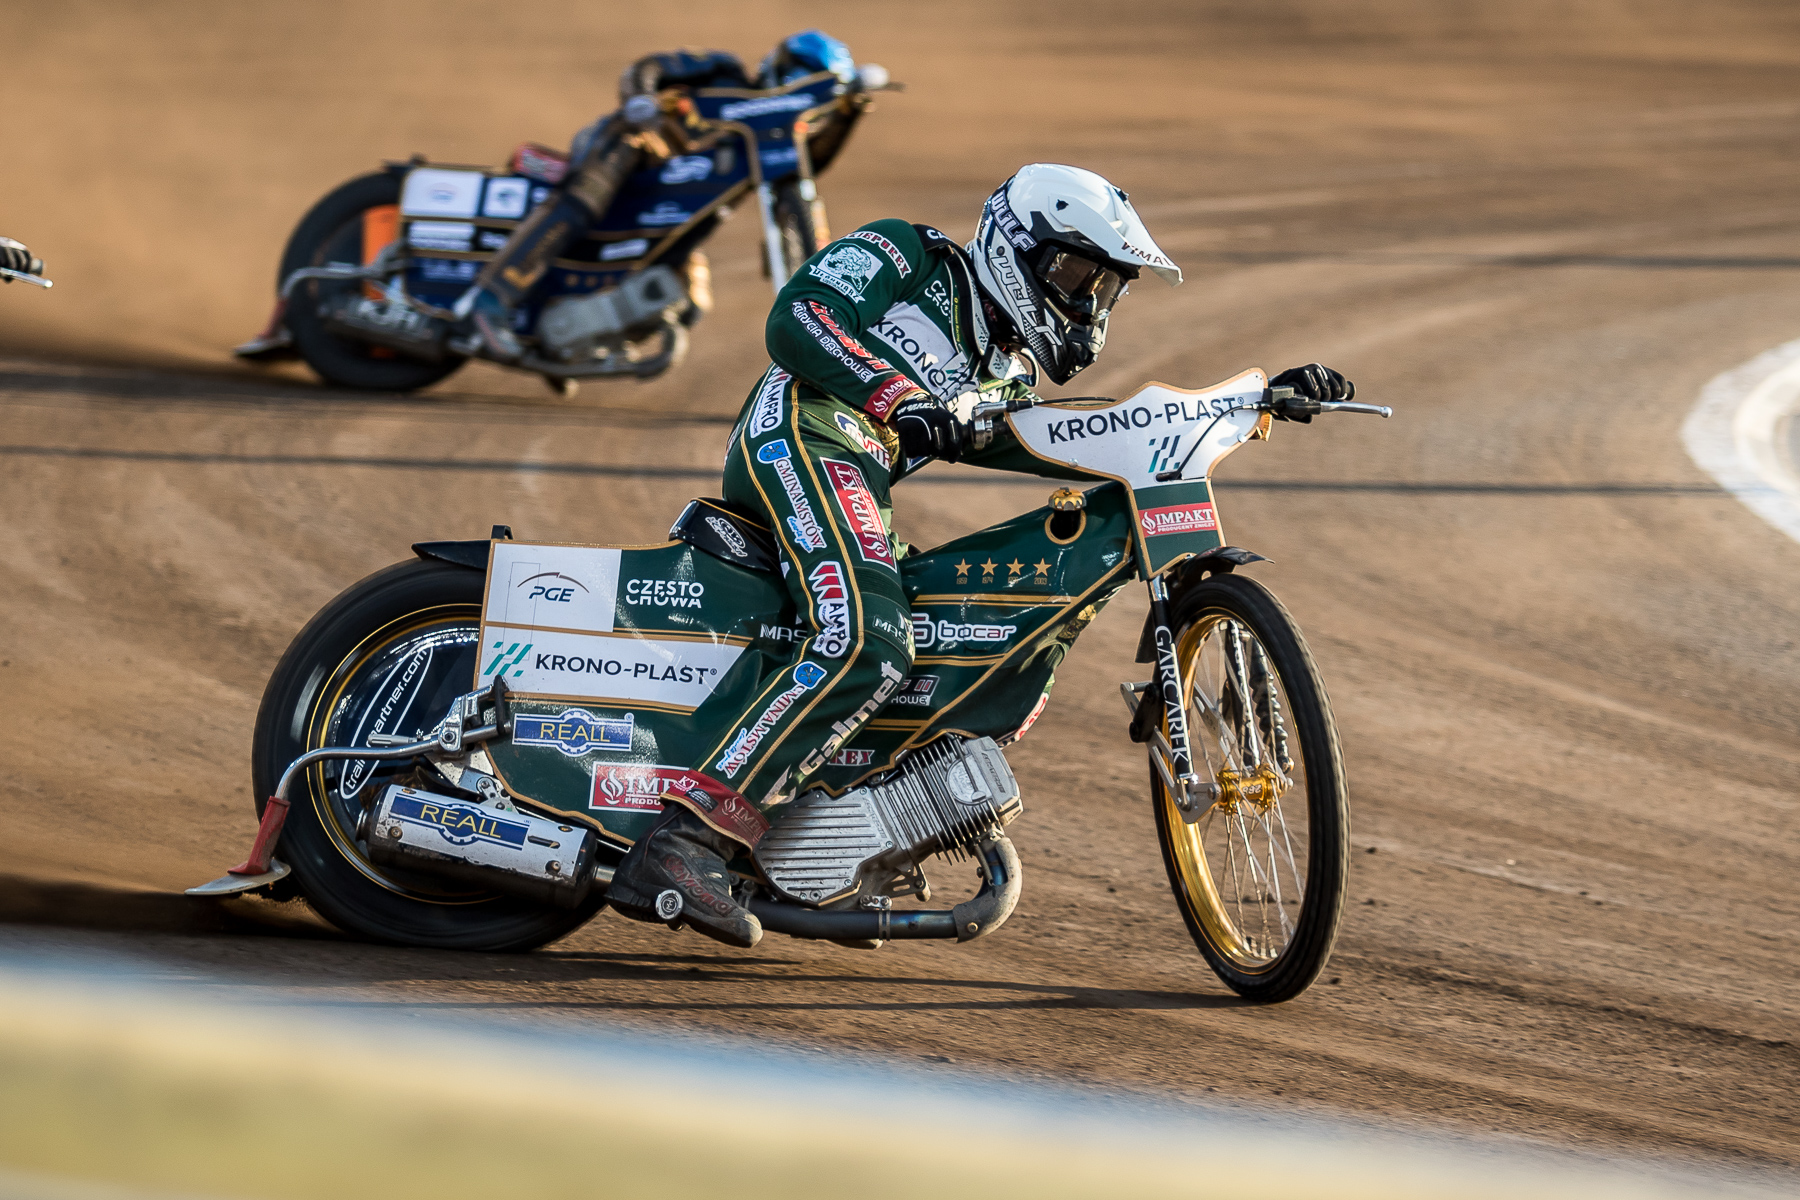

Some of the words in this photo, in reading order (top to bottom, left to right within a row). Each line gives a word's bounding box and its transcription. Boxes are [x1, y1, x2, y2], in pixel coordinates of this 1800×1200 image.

[990, 189, 1037, 251] WULF
[776, 459, 803, 501] GMINA
[834, 465, 879, 540] IMPAKT
[1155, 508, 1213, 525] IMPAKT
[529, 586, 575, 602] PGE
[540, 723, 611, 743] REALL
[800, 660, 903, 776] Galmet
[625, 798, 661, 807] PRODU
[420, 805, 501, 838] REALL
